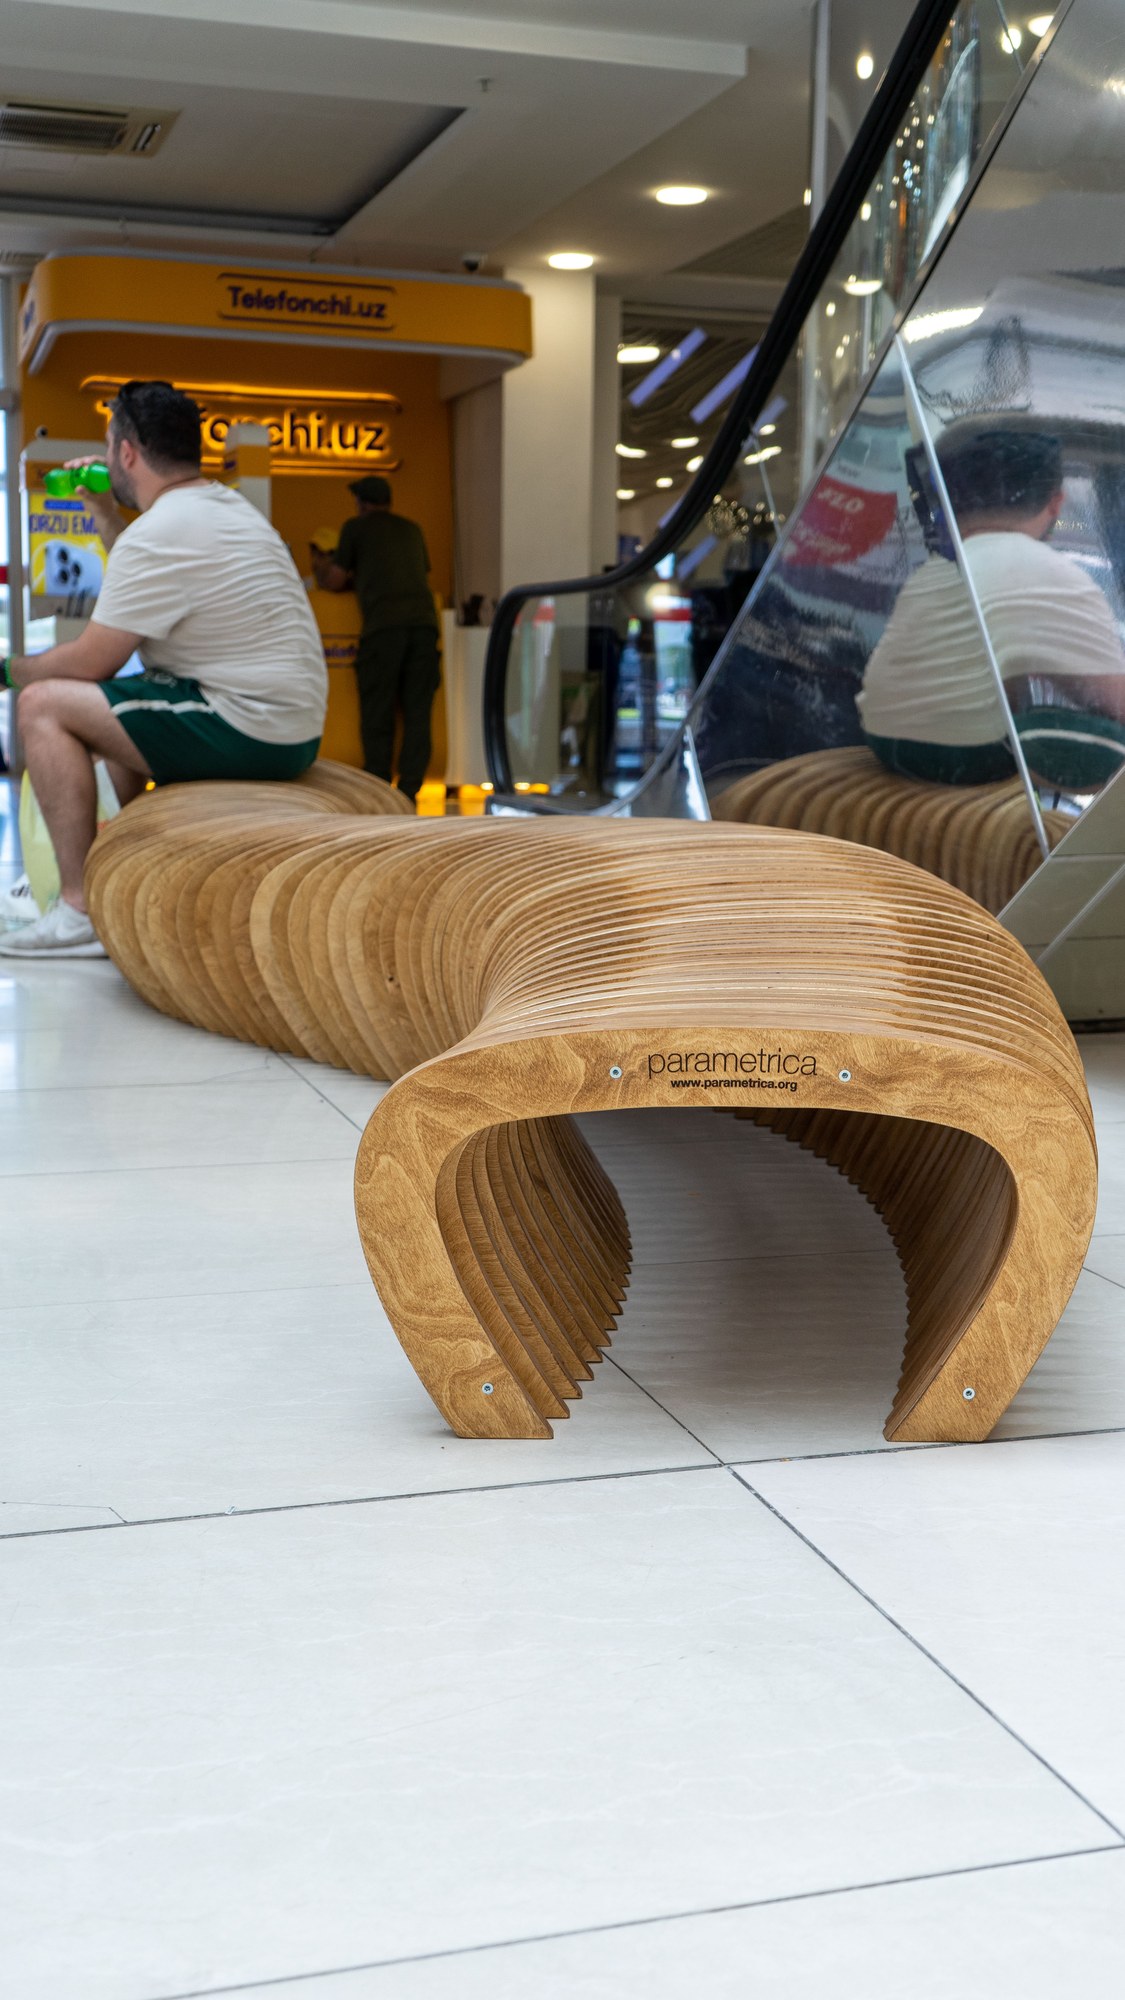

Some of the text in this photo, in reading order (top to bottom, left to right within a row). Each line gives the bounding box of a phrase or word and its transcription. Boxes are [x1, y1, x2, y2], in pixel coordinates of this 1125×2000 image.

[227, 285, 387, 319] Telefonchi.uz
[647, 1047, 818, 1079] parametrica
[670, 1077, 798, 1092] www.parametrica.org
